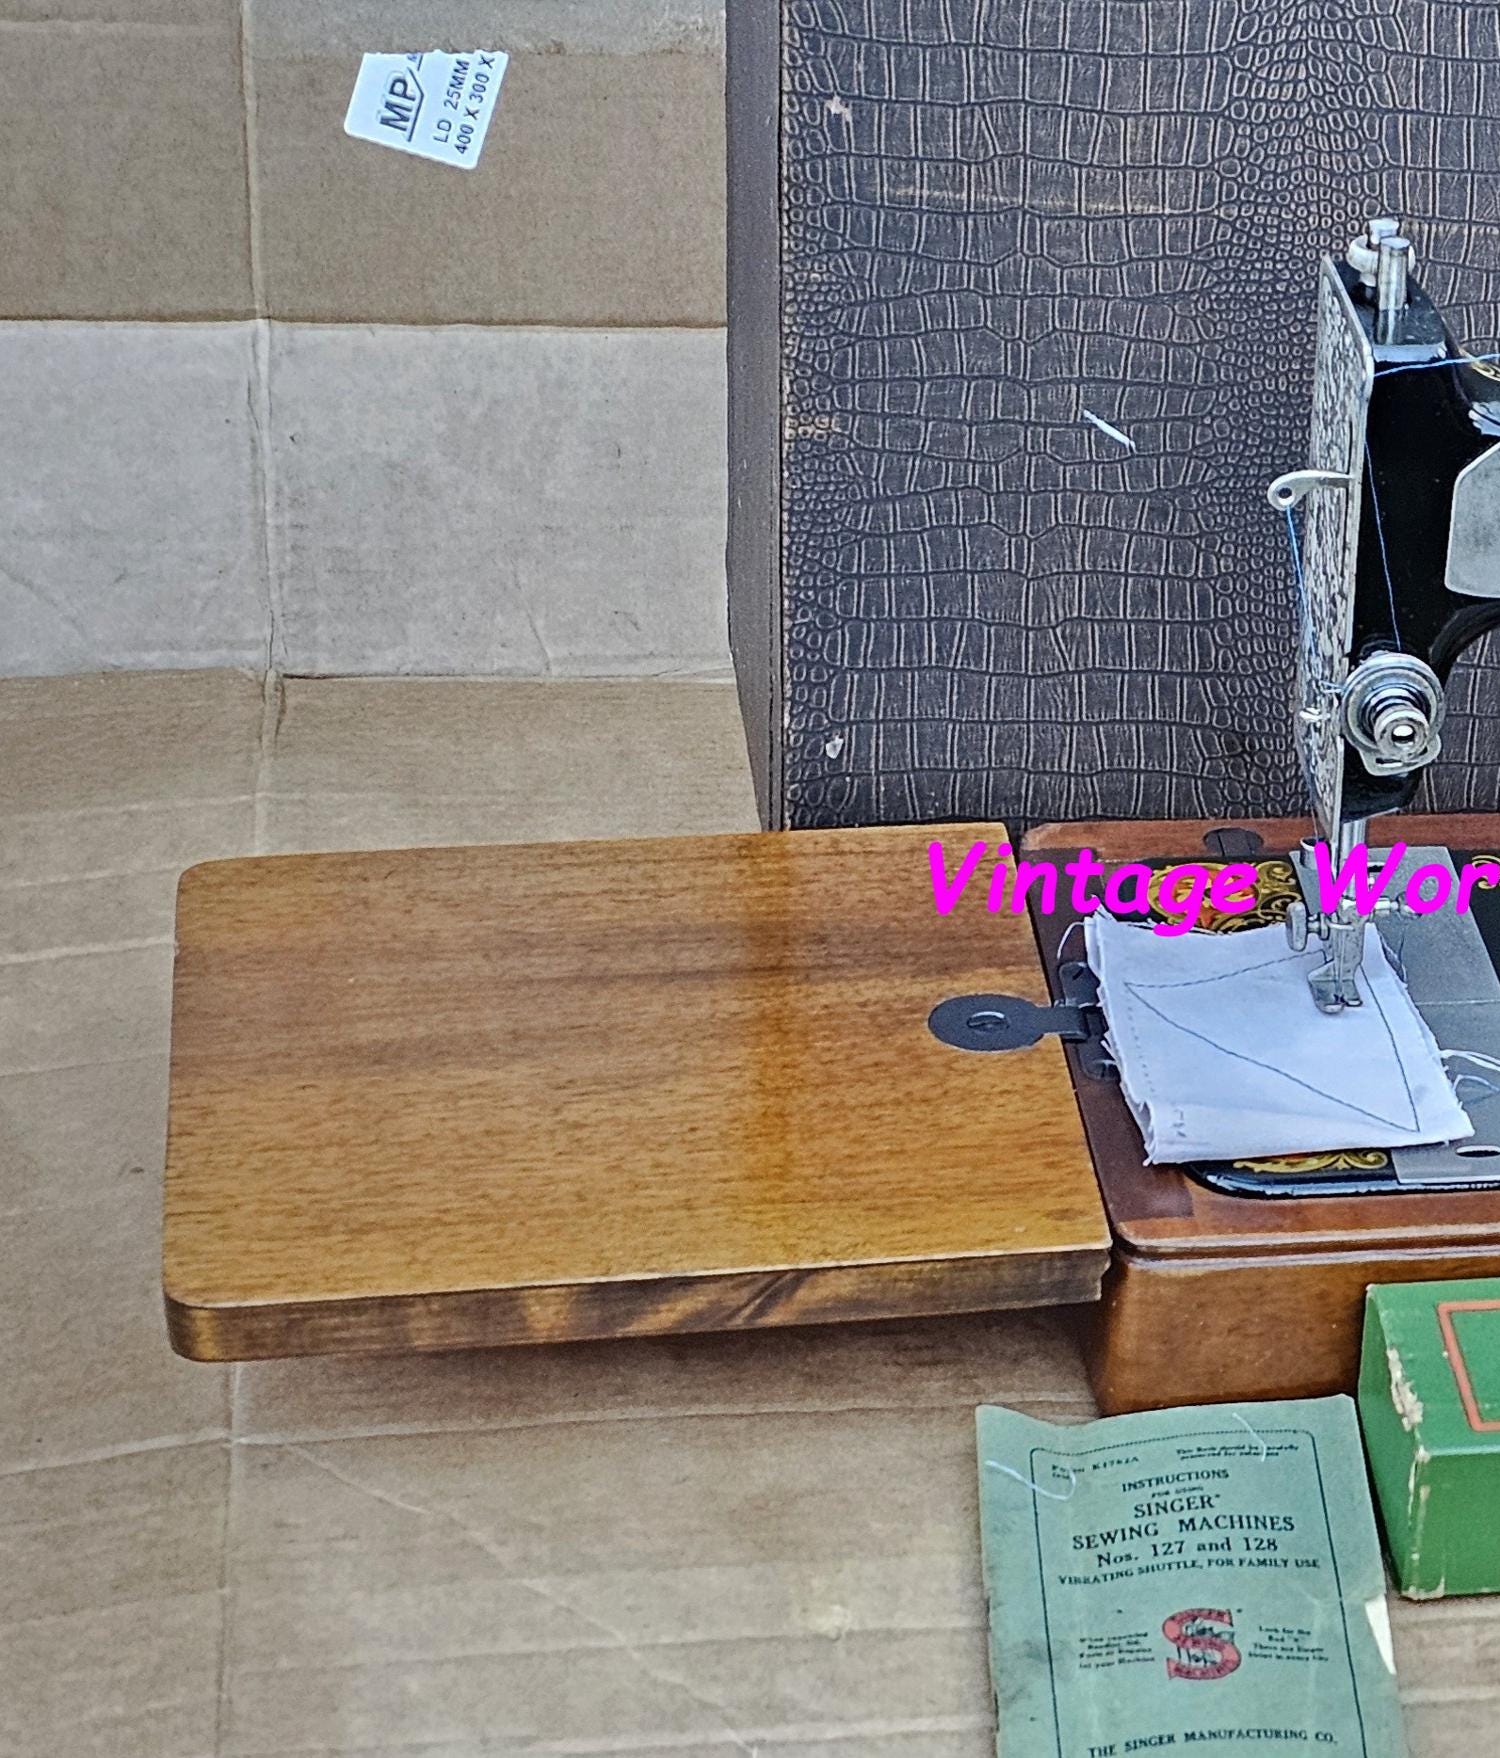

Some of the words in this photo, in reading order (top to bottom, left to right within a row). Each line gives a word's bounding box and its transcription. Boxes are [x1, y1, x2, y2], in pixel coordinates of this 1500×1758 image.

[479, 54, 496, 69] X
[433, 118, 452, 144] LD
[443, 58, 471, 111] 25MM
[468, 73, 490, 104] 300
[379, 77, 417, 132] MP
[463, 107, 480, 121] X
[454, 123, 475, 155] 400
[1122, 1468, 1230, 1493] INSTRUCTIONS
[1133, 1494, 1215, 1519] SINGER
[1072, 1521, 1160, 1551] SEWING
[1178, 1514, 1296, 1533] MACHINES
[1097, 1552, 1139, 1569] Nos.
[1150, 1540, 1186, 1557] 127
[1196, 1536, 1233, 1553] and
[1243, 1536, 1279, 1552] 128
[1058, 1568, 1135, 1586] VIBRATING
[1207, 1557, 1234, 1568] FOR
[1238, 1557, 1289, 1569] FAMILY
[1089, 1743, 1117, 1758] THE
[1124, 1733, 1176, 1753] SINGER
[1184, 1728, 1309, 1743] MANUFACTURING
